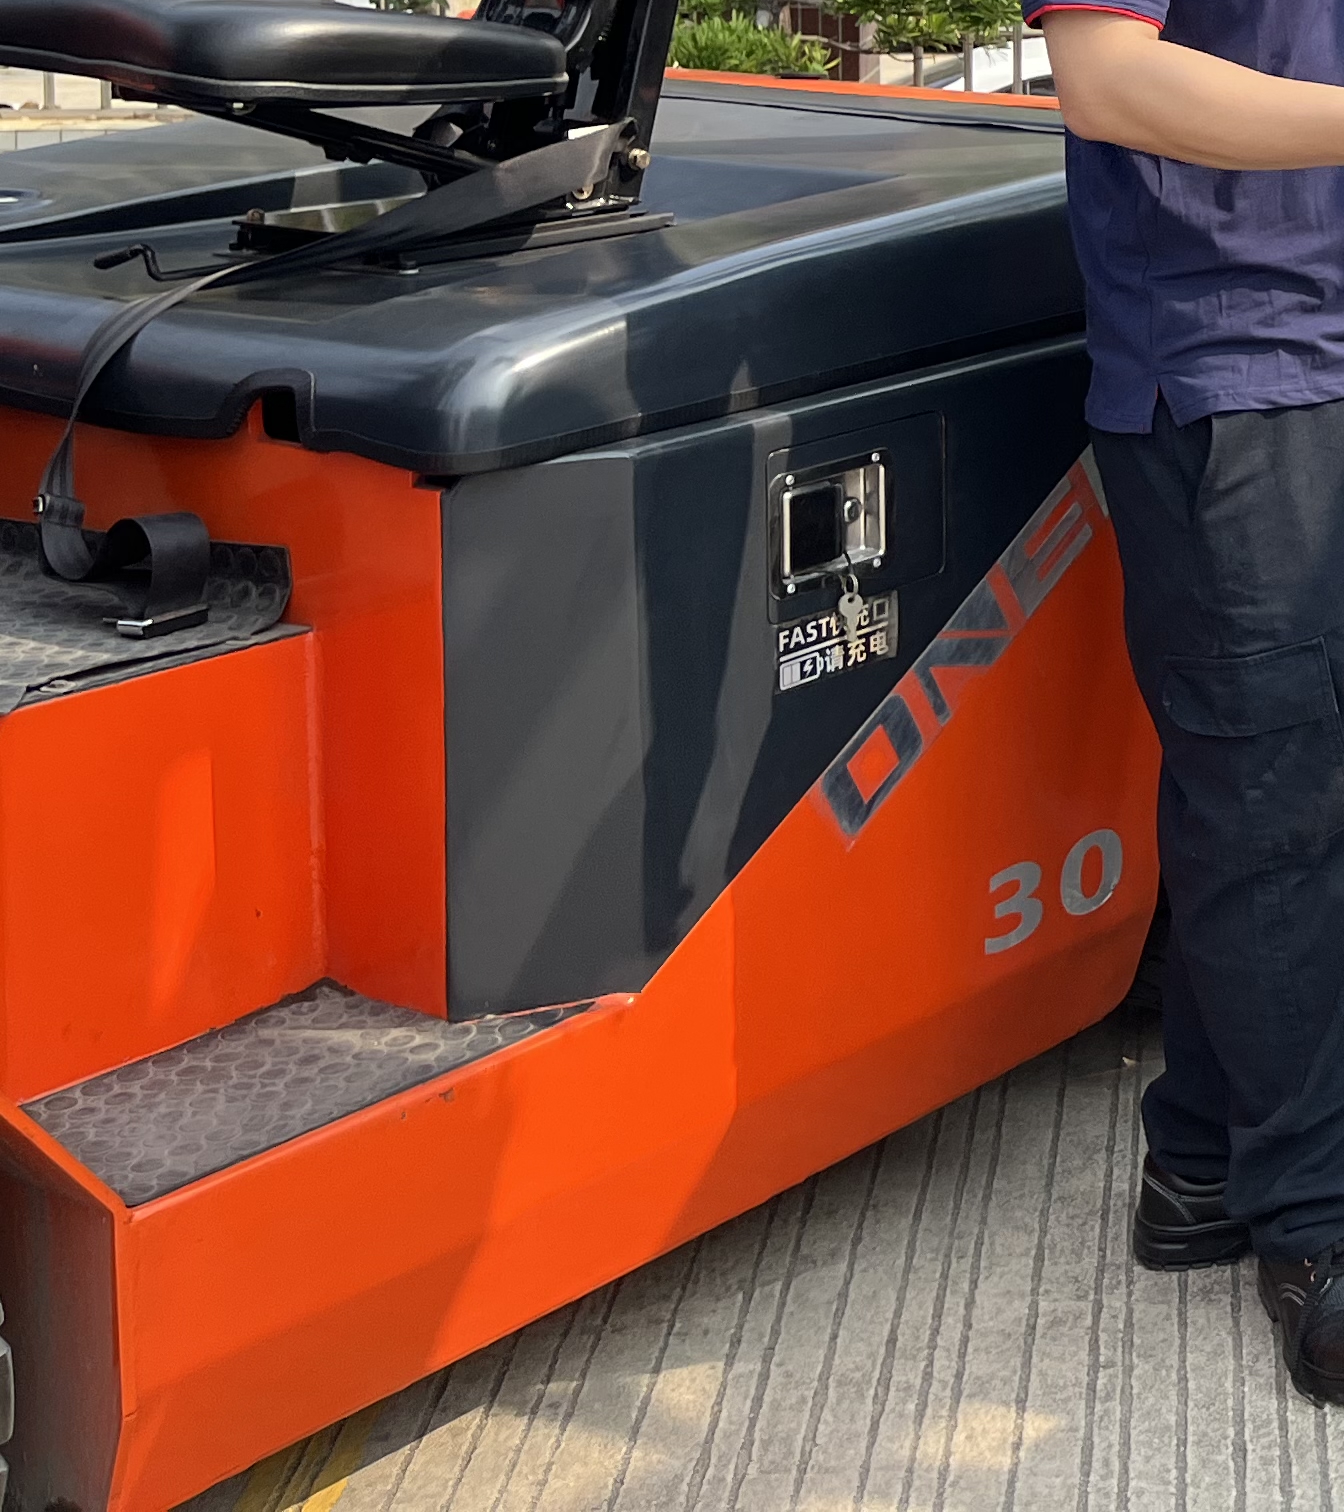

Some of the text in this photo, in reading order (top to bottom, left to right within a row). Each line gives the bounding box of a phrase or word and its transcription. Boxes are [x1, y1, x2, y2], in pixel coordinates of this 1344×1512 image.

[820, 444, 1108, 837] ONE
[825, 631, 889, 673] 请充电
[985, 828, 1123, 955] 30
